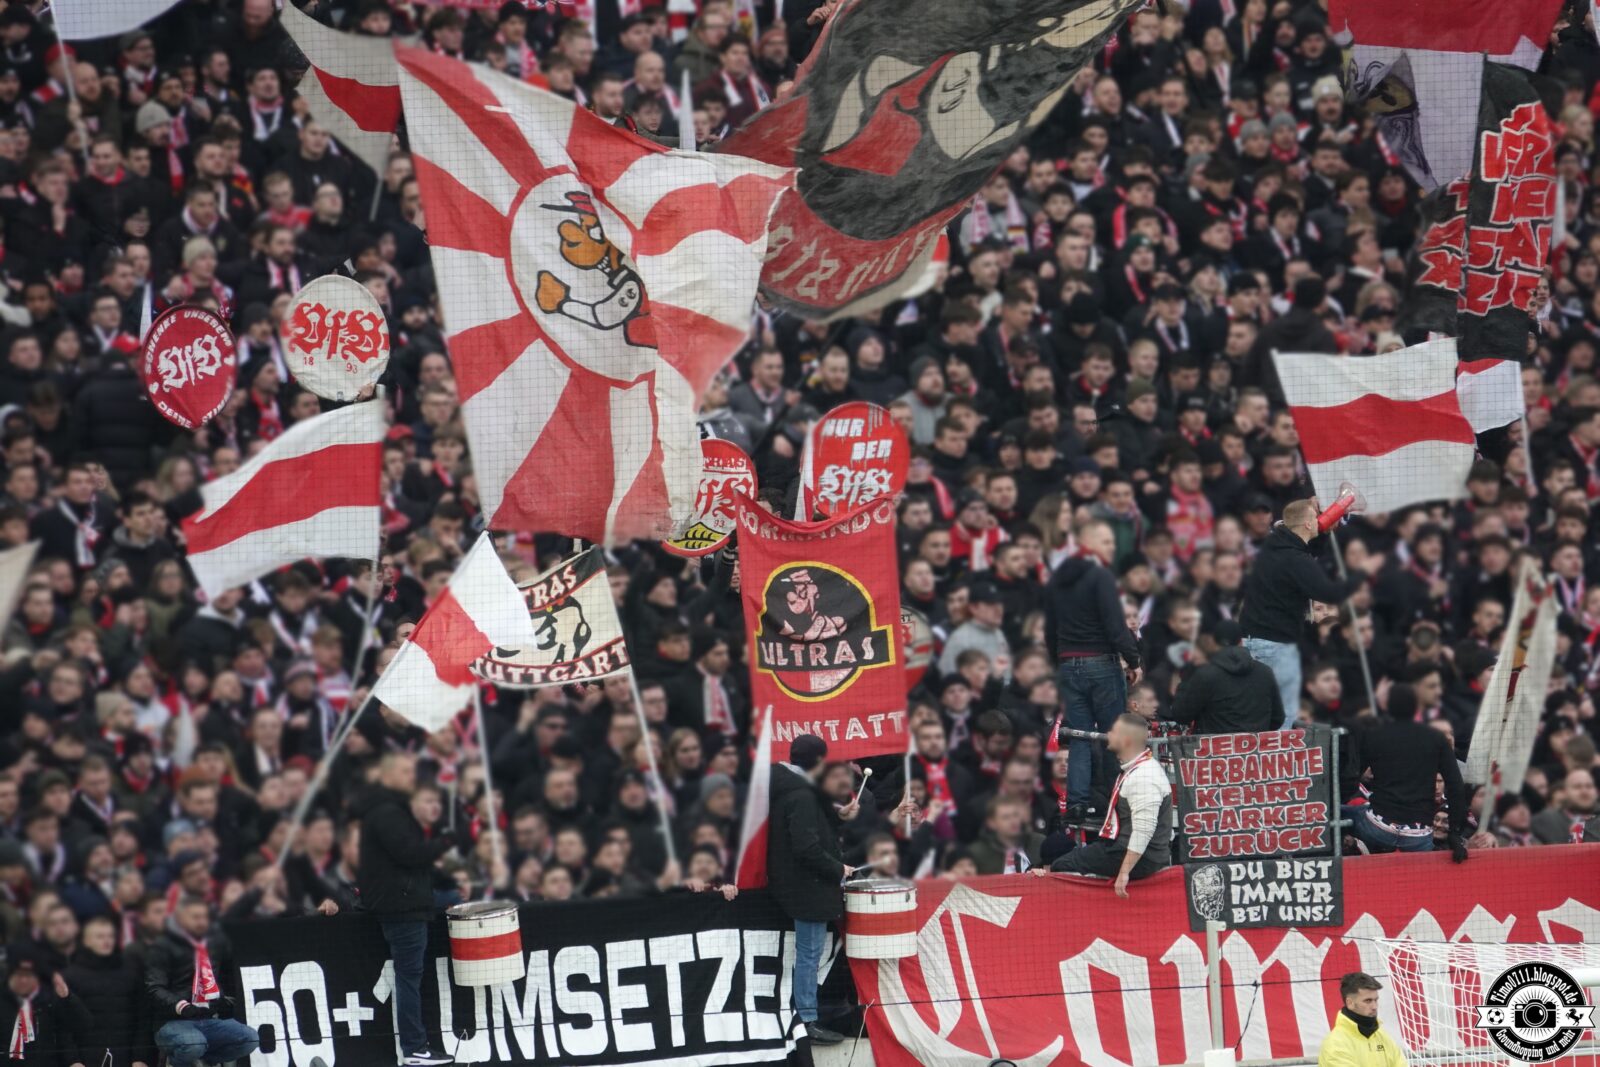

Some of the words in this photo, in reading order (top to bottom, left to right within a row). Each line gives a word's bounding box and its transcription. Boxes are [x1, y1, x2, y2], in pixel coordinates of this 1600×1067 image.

[144, 313, 177, 375] SCHENKE
[183, 309, 233, 347] UNSEREM
[303, 356, 314, 366] 18
[345, 362, 358, 374] 93
[157, 400, 193, 430] DEINE
[822, 418, 865, 437] NUR
[852, 439, 893, 460] DER
[761, 636, 875, 667] ULTRAS
[771, 711, 906, 743] NNSTATT
[1194, 729, 1306, 758] JEDER
[1179, 747, 1324, 786] VERBANNTE
[1195, 777, 1313, 809] KEHRT
[1188, 826, 1327, 858] ZURÜCK
[1228, 862, 1265, 882] DU
[1275, 860, 1333, 880] BIST
[1231, 881, 1334, 905] IMMER
[1231, 905, 1269, 923] BEI
[1279, 904, 1335, 922] UNS!
